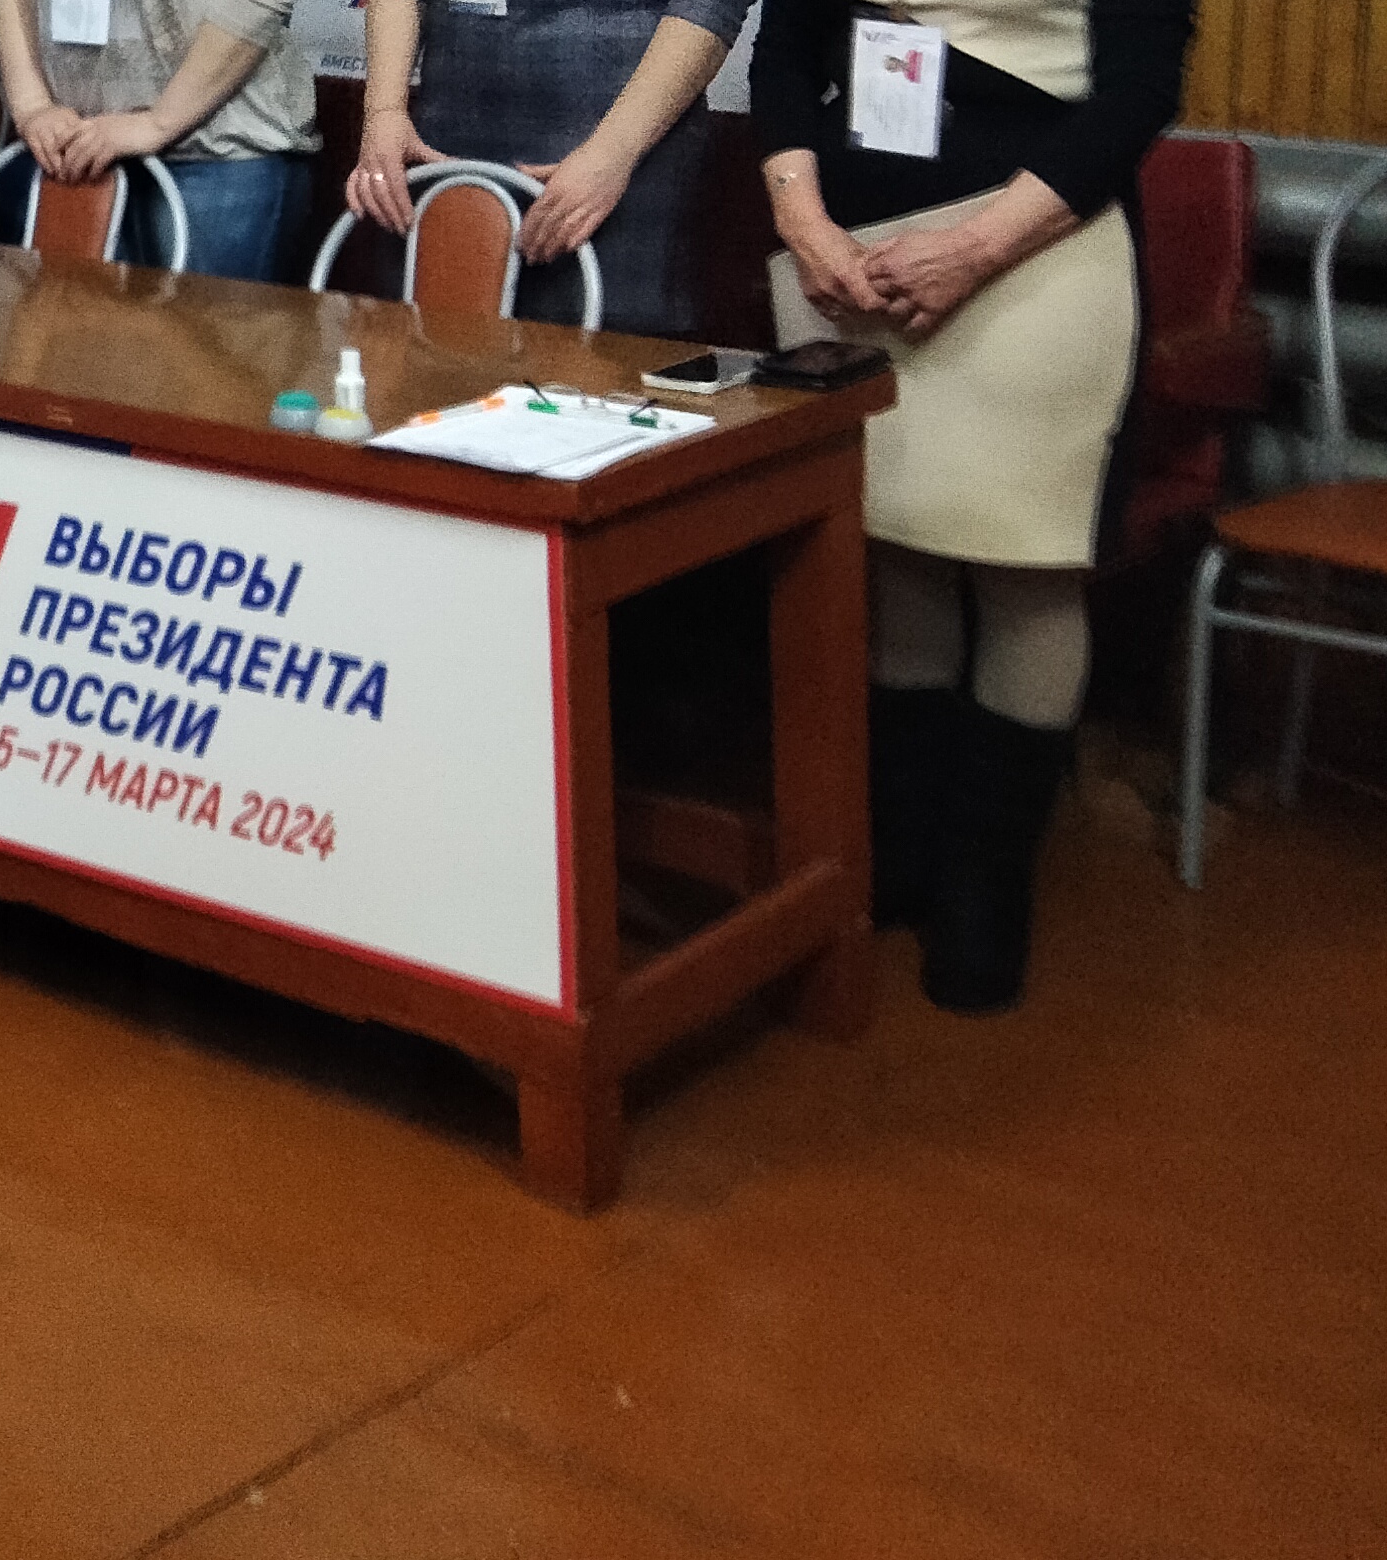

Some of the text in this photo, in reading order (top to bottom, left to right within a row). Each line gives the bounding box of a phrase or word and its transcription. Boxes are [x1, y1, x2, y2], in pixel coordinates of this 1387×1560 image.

[44, 515, 304, 617] ВЫБОРЫ
[20, 586, 388, 721] ПРЕЗИДЕНТА
[85, 750, 223, 830] МАРТА
[229, 790, 337, 861] 2024
